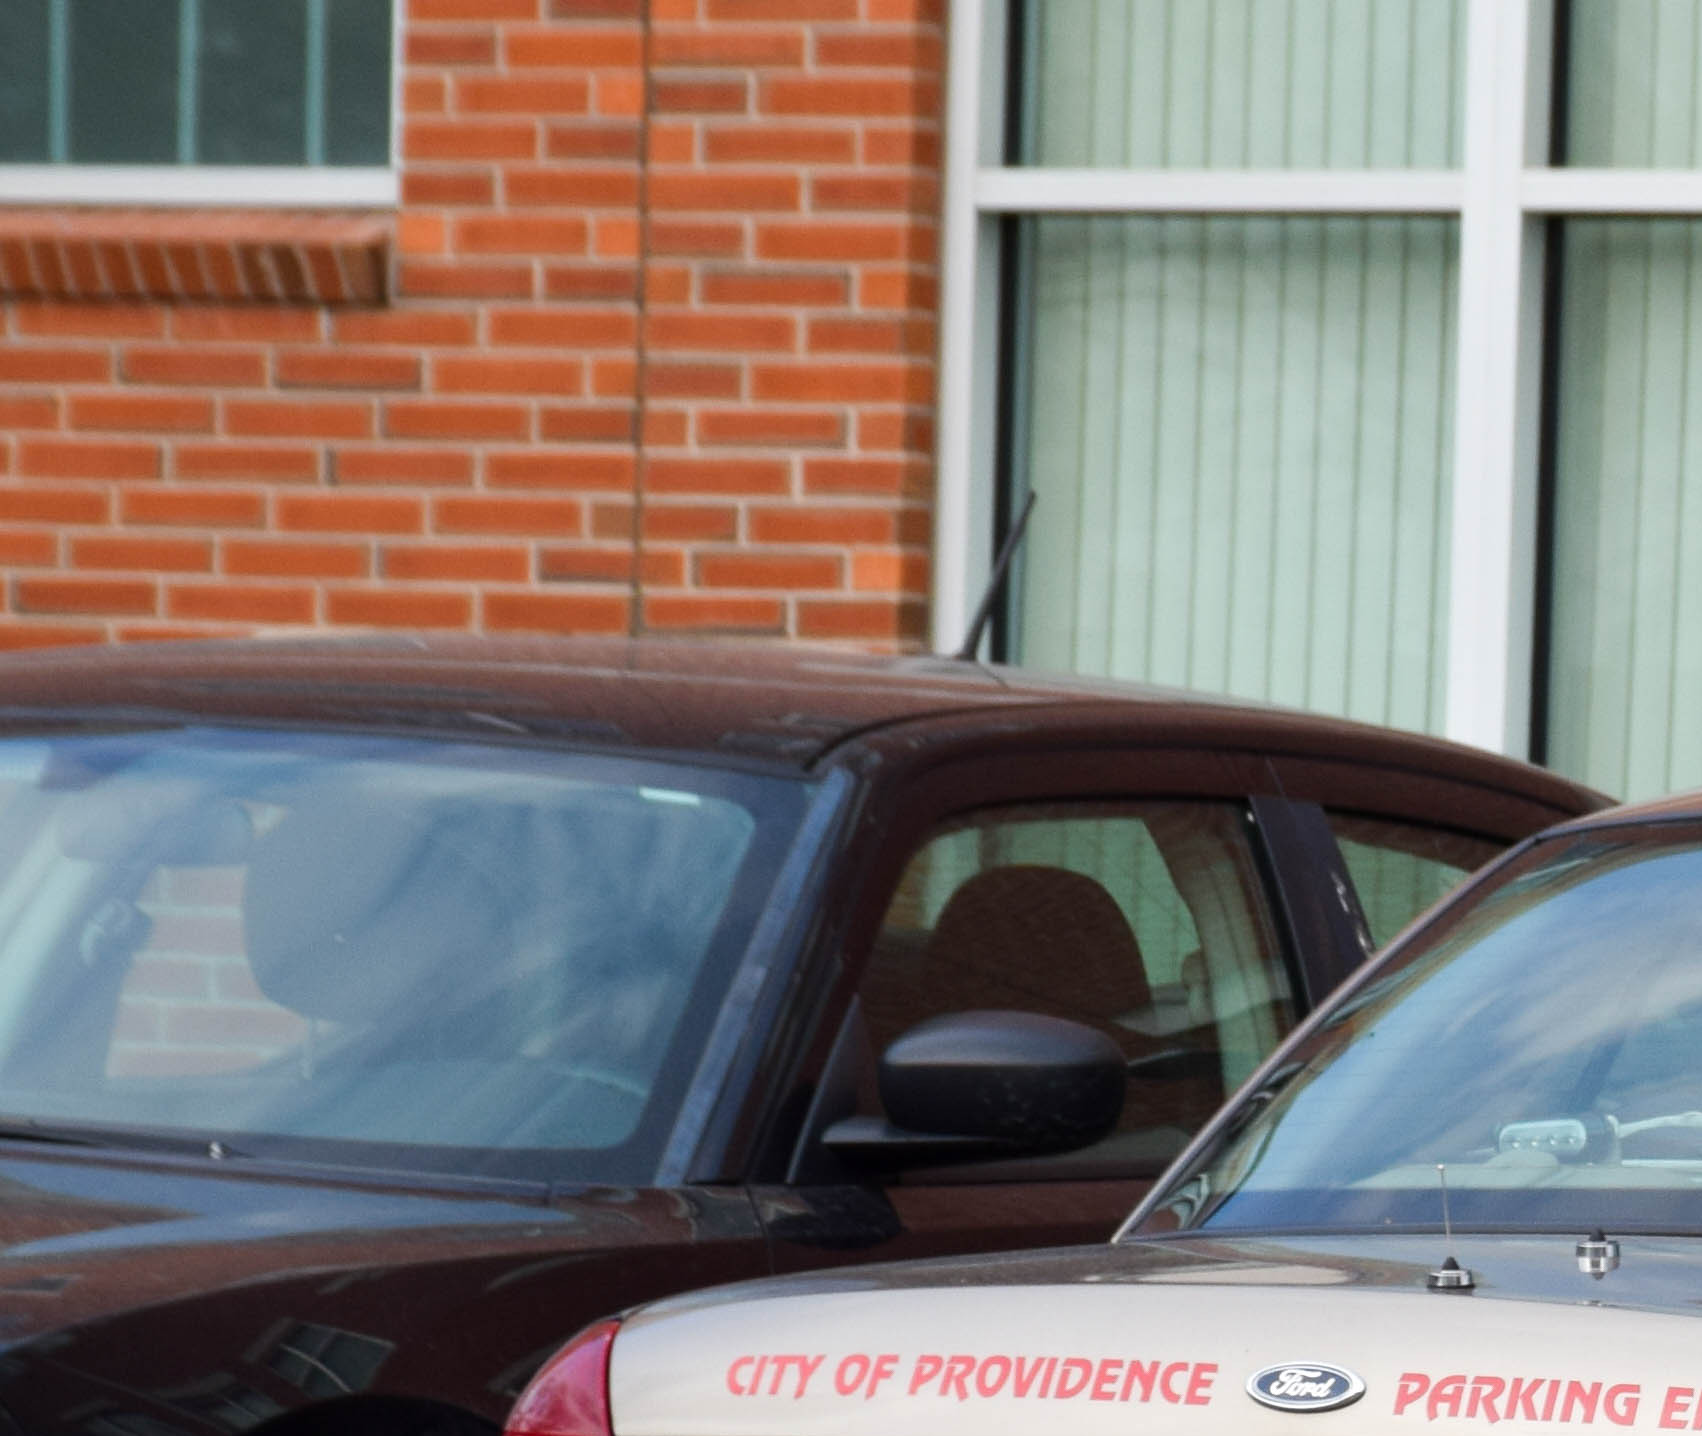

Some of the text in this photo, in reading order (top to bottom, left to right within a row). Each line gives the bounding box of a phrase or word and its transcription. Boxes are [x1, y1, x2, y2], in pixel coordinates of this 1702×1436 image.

[726, 1354, 1219, 1405] CITY OF PROVIDENCE
[1269, 1368, 1336, 1398] Ford
[1394, 1373, 1642, 1425] PARKING
